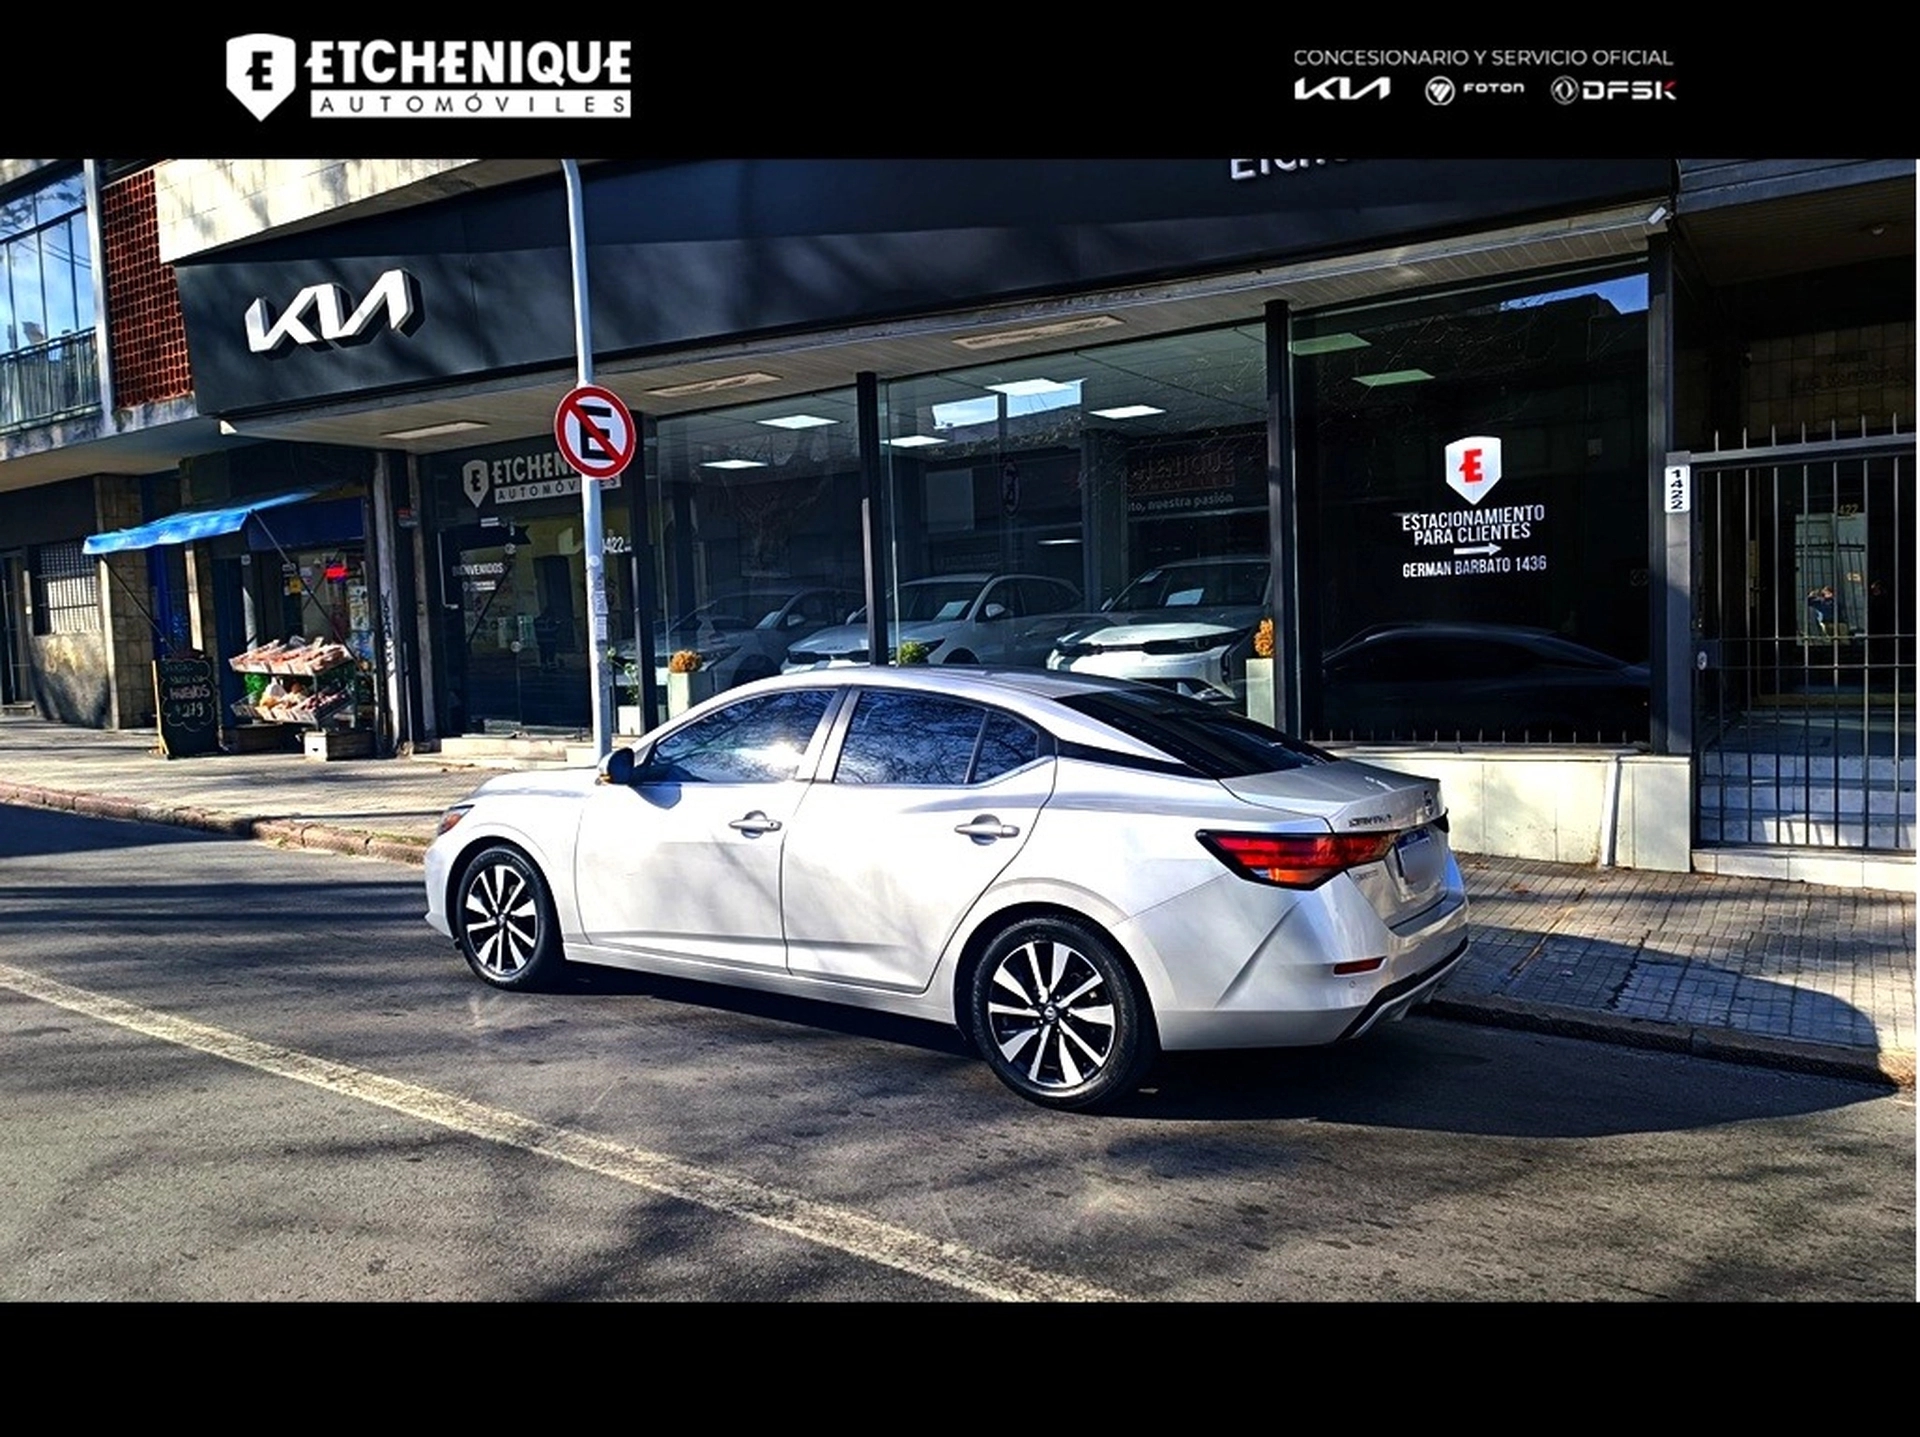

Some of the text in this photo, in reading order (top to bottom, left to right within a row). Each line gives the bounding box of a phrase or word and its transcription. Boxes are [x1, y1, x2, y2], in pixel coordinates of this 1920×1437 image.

[244, 268, 414, 353] KIA
[578, 404, 612, 460] E
[1459, 449, 1483, 483] E
[1670, 468, 1684, 510] 1422
[1402, 504, 1545, 531] ESTACIONAMIENTO
[1414, 522, 1531, 546] PARA CLIENTES
[1403, 555, 1547, 578] GERMAN BARBATO 1436
